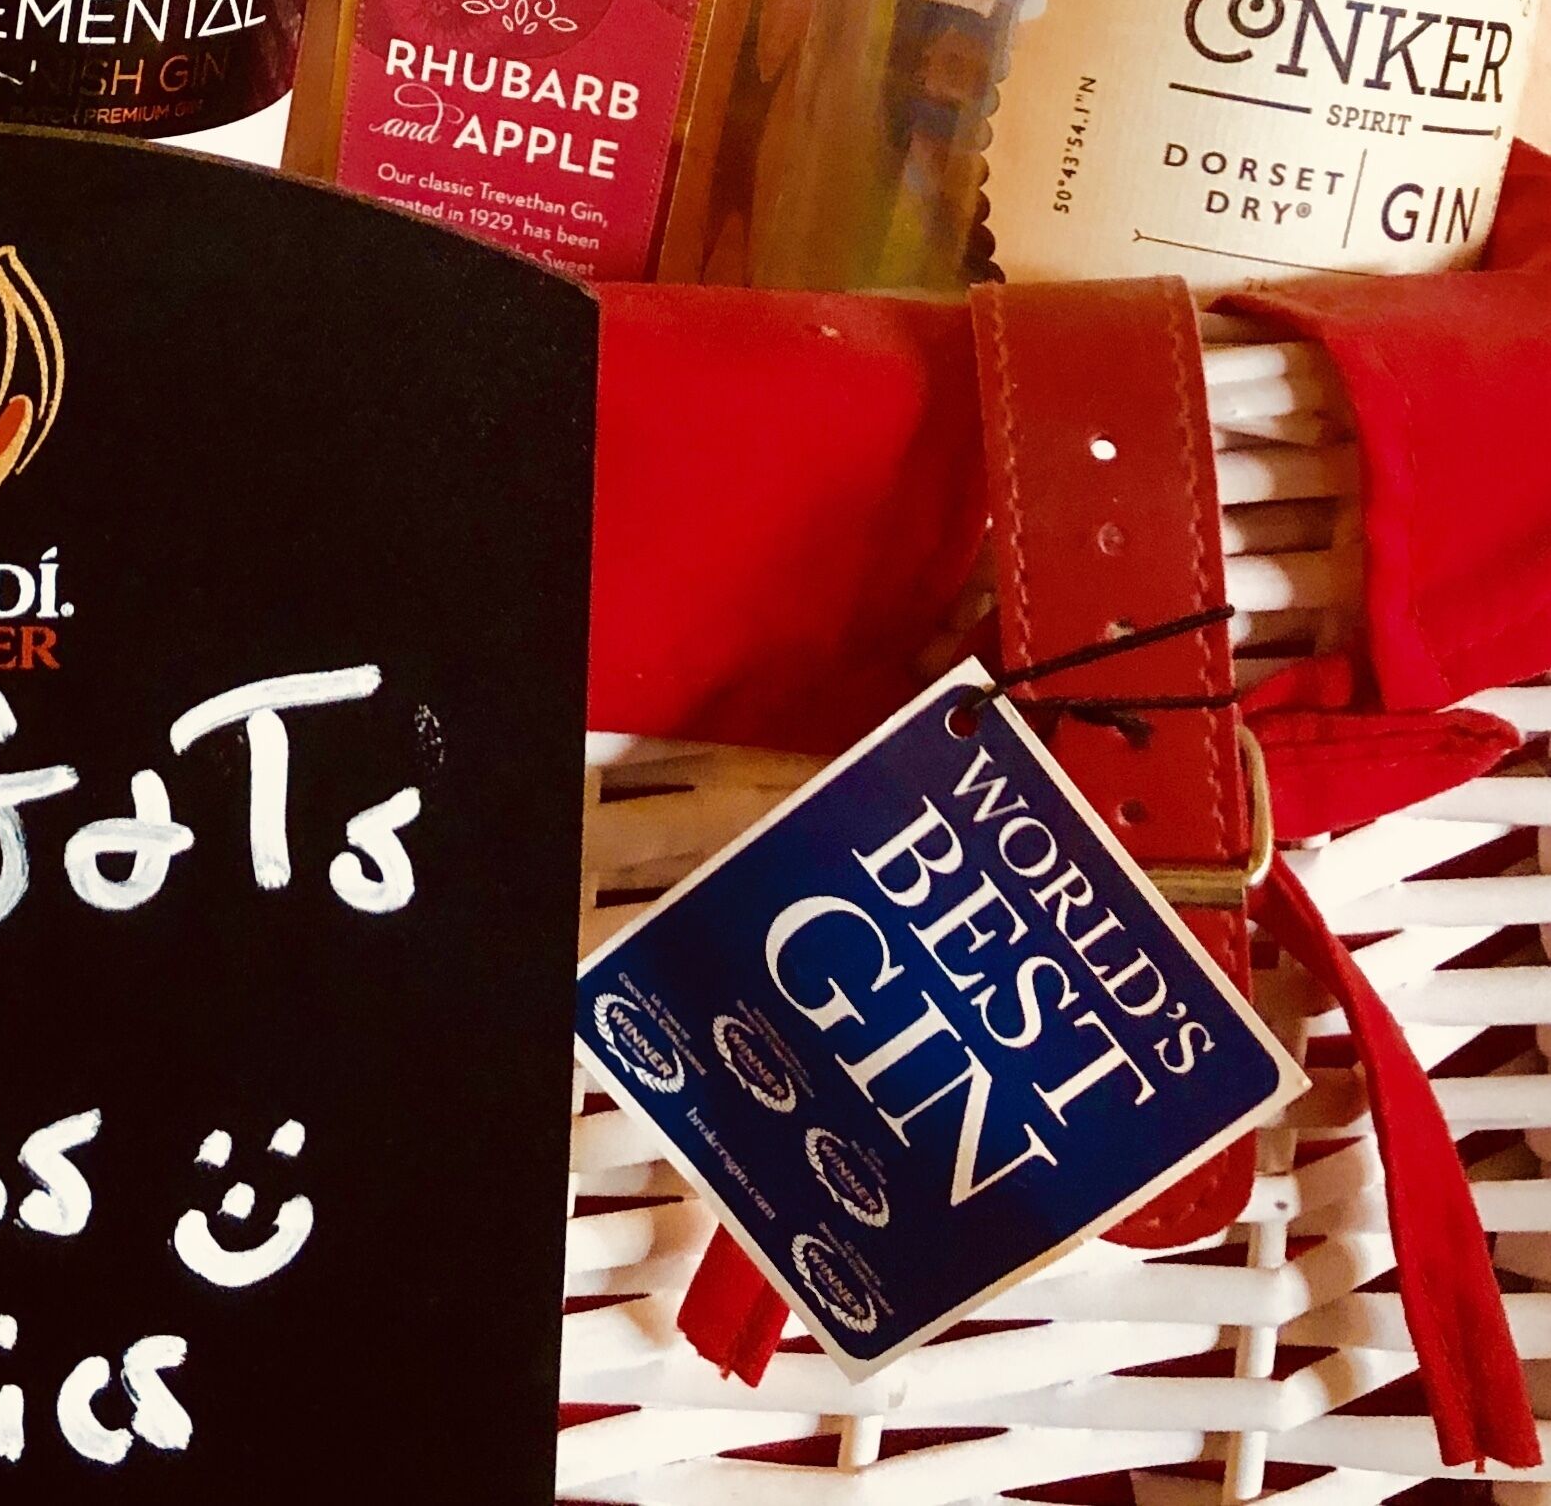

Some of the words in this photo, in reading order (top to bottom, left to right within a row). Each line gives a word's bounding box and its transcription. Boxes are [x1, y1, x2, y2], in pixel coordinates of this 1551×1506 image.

[84, 103, 170, 126] PREMIUM
[385, 38, 641, 121] RHUBARB
[369, 82, 465, 144] and
[452, 114, 620, 181] APPLE
[1326, 104, 1413, 137] SPIRIT
[377, 162, 415, 185] Our
[418, 171, 474, 198] classic
[479, 181, 566, 216] Trevethan
[570, 201, 609, 228] Gin,
[1162, 141, 1346, 196] DORSET
[447, 203, 464, 224] in
[469, 207, 519, 236] 1929,
[523, 218, 552, 240] has
[556, 224, 600, 250] been
[1380, 181, 1481, 245] GIN
[951, 745, 1216, 1076] WORLD'S
[851, 795, 1156, 1128] BEST
[610, 1005, 674, 1079] WINNER
[729, 1026, 786, 1097] WINNER
[764, 895, 1058, 1208] GIN
[820, 1137, 878, 1215] WINNER
[807, 1246, 866, 1316] WINNER
